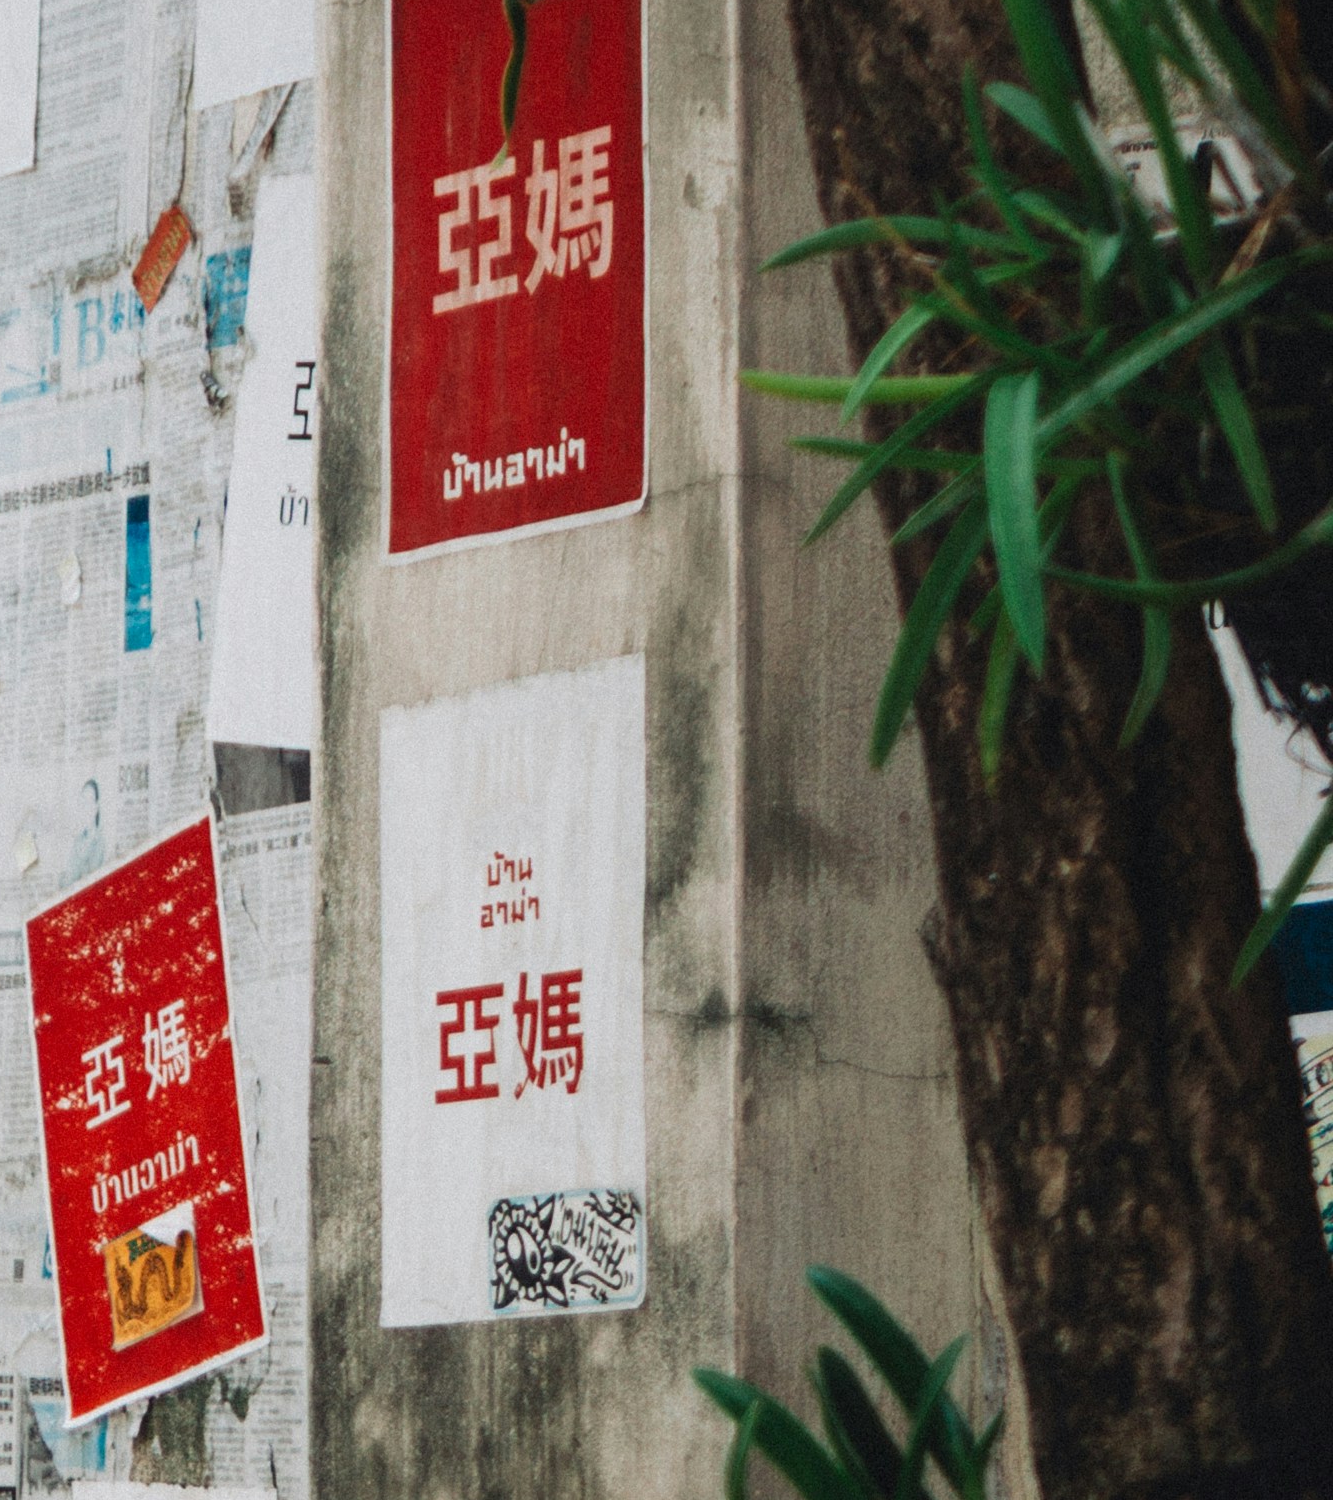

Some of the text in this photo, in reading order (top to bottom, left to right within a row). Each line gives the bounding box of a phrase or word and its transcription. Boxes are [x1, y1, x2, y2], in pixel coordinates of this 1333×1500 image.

[430, 125, 615, 316] 亞媽
[442, 427, 587, 501] บ้านอาม่า
[480, 889, 541, 929] อาม่า
[486, 851, 535, 888] บ้าน
[81, 999, 191, 1131] 亞媽
[435, 967, 586, 1104] 亞媽
[91, 1130, 201, 1214] บ้านอาม่า
